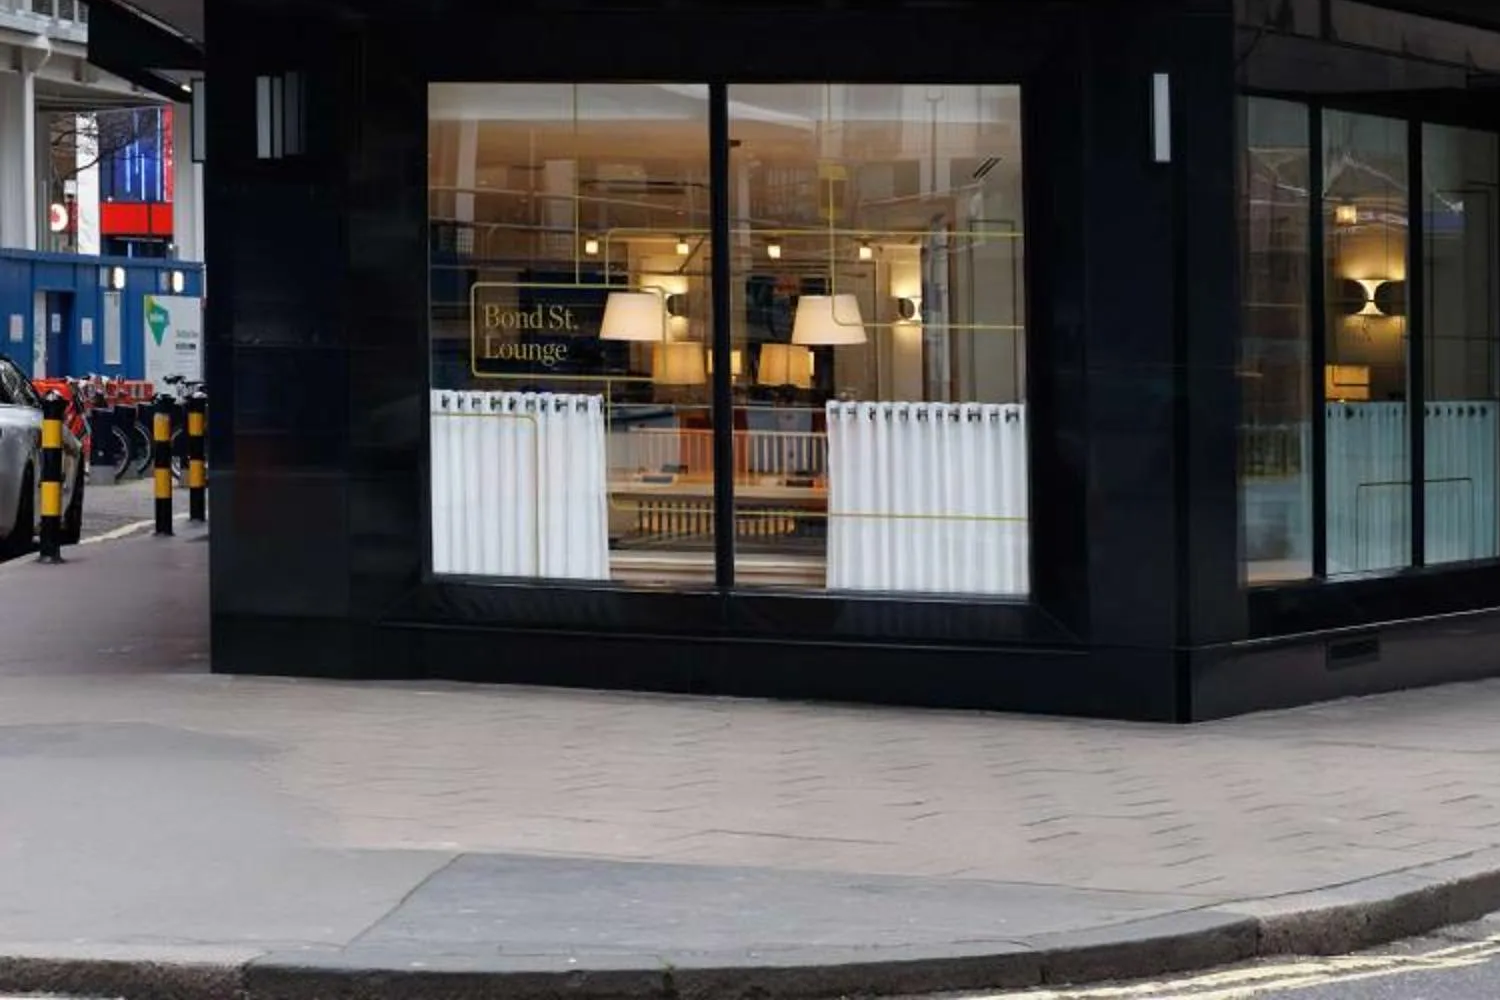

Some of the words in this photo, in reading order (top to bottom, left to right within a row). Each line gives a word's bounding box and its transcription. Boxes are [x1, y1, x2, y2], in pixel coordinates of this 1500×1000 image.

[484, 303, 543, 330] Bond
[549, 304, 579, 330] St.
[484, 335, 568, 367] Lounge
